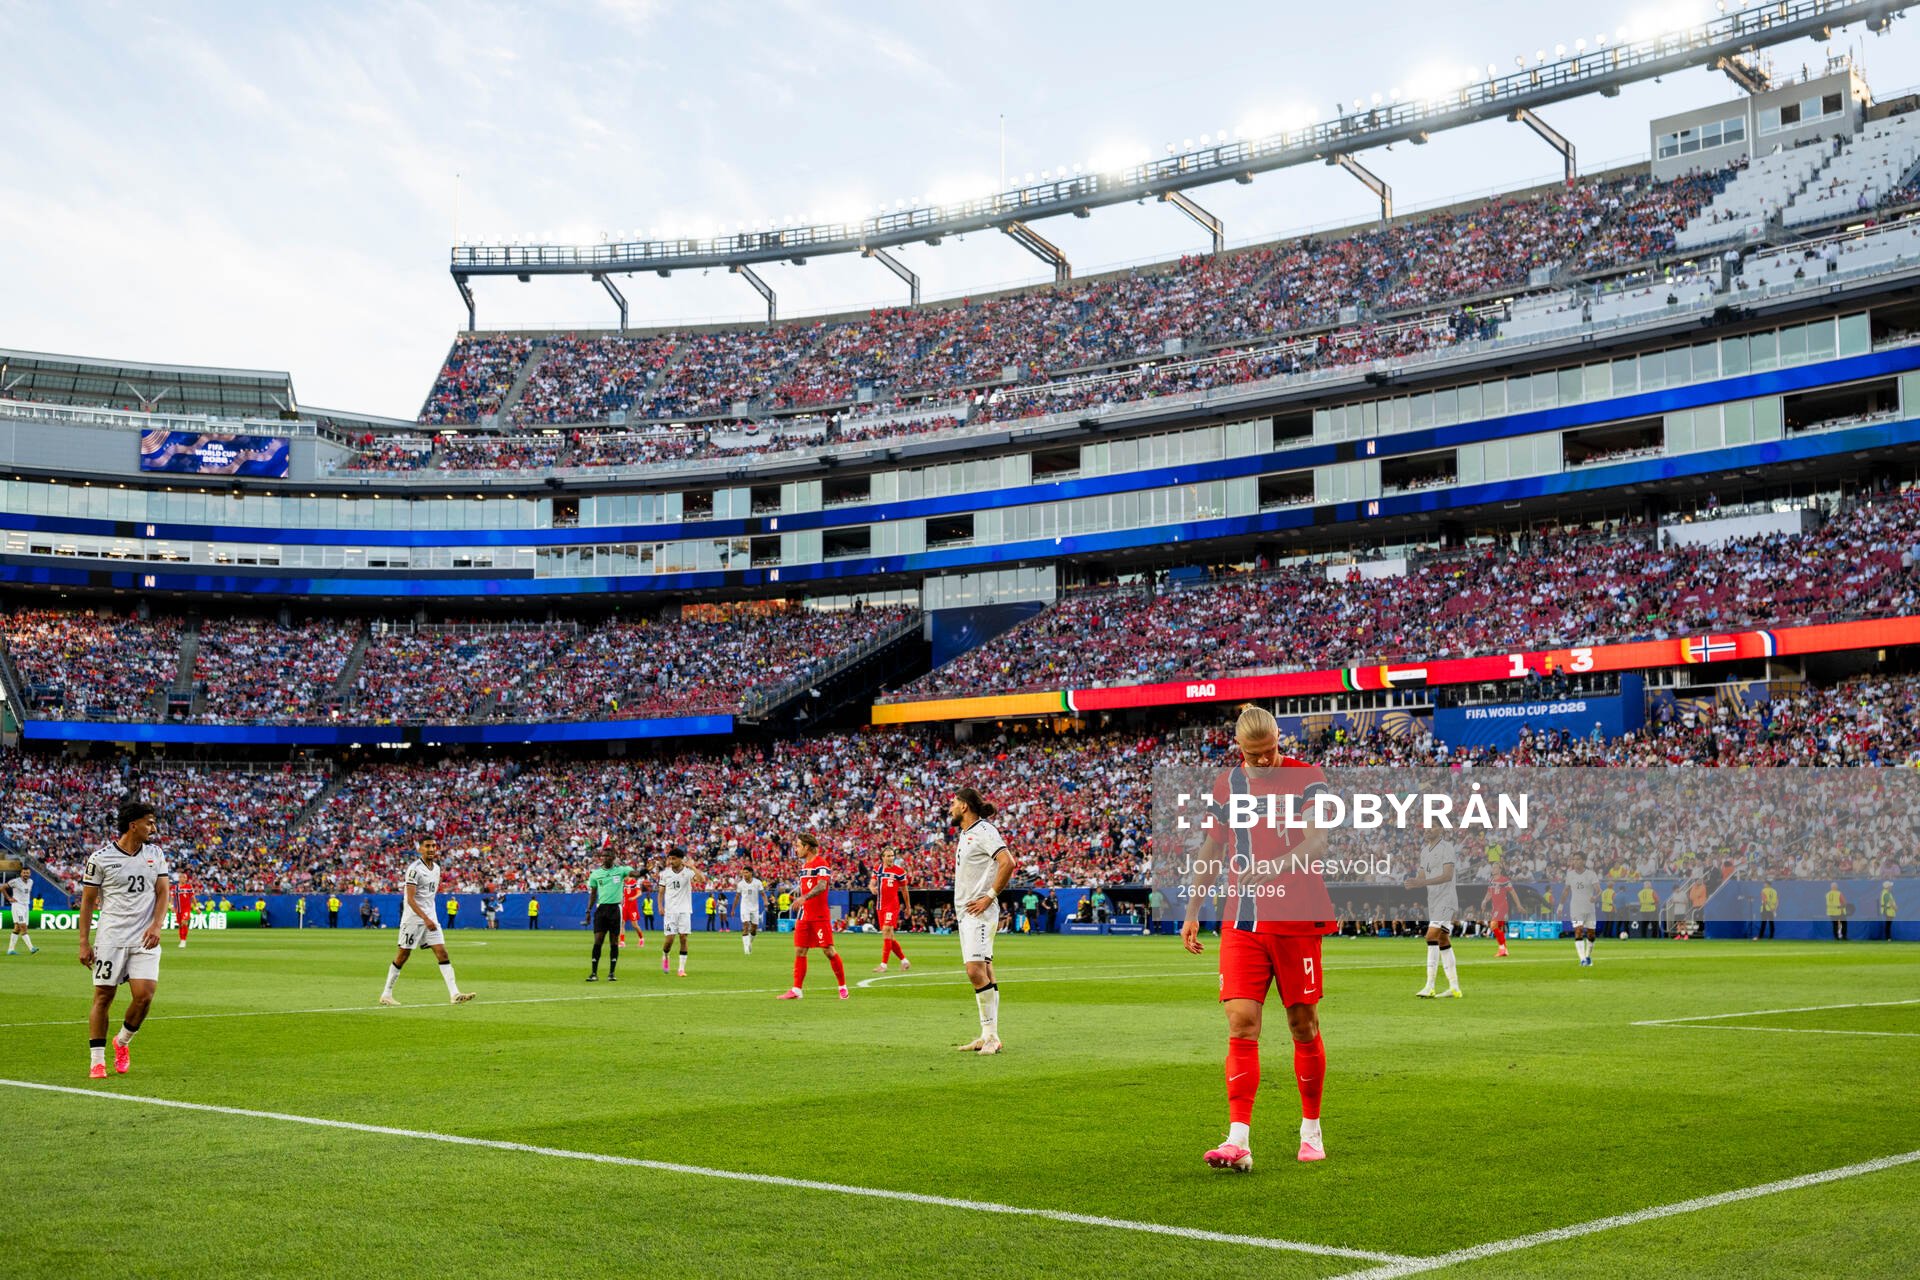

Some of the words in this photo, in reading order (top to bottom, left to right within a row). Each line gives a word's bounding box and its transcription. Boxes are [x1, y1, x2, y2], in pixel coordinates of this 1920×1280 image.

[195, 449, 221, 457] WORLD
[222, 450, 237, 458] CUP
[208, 443, 224, 451] FIFA
[1508, 654, 1529, 677] 1
[1570, 648, 1594, 673] 3
[1186, 683, 1216, 698] IRAQ
[1466, 708, 1487, 719] FIFA
[1488, 706, 1525, 718] WORLD
[1527, 705, 1548, 716] CUP
[1549, 702, 1586, 714] 2026
[128, 875, 145, 893] 23
[673, 881, 680, 889] 14
[807, 878, 813, 889] 6
[405, 933, 414, 945] 16
[817, 928, 823, 939] 6
[96, 959, 113, 979] 23
[1303, 957, 1315, 984] 9
